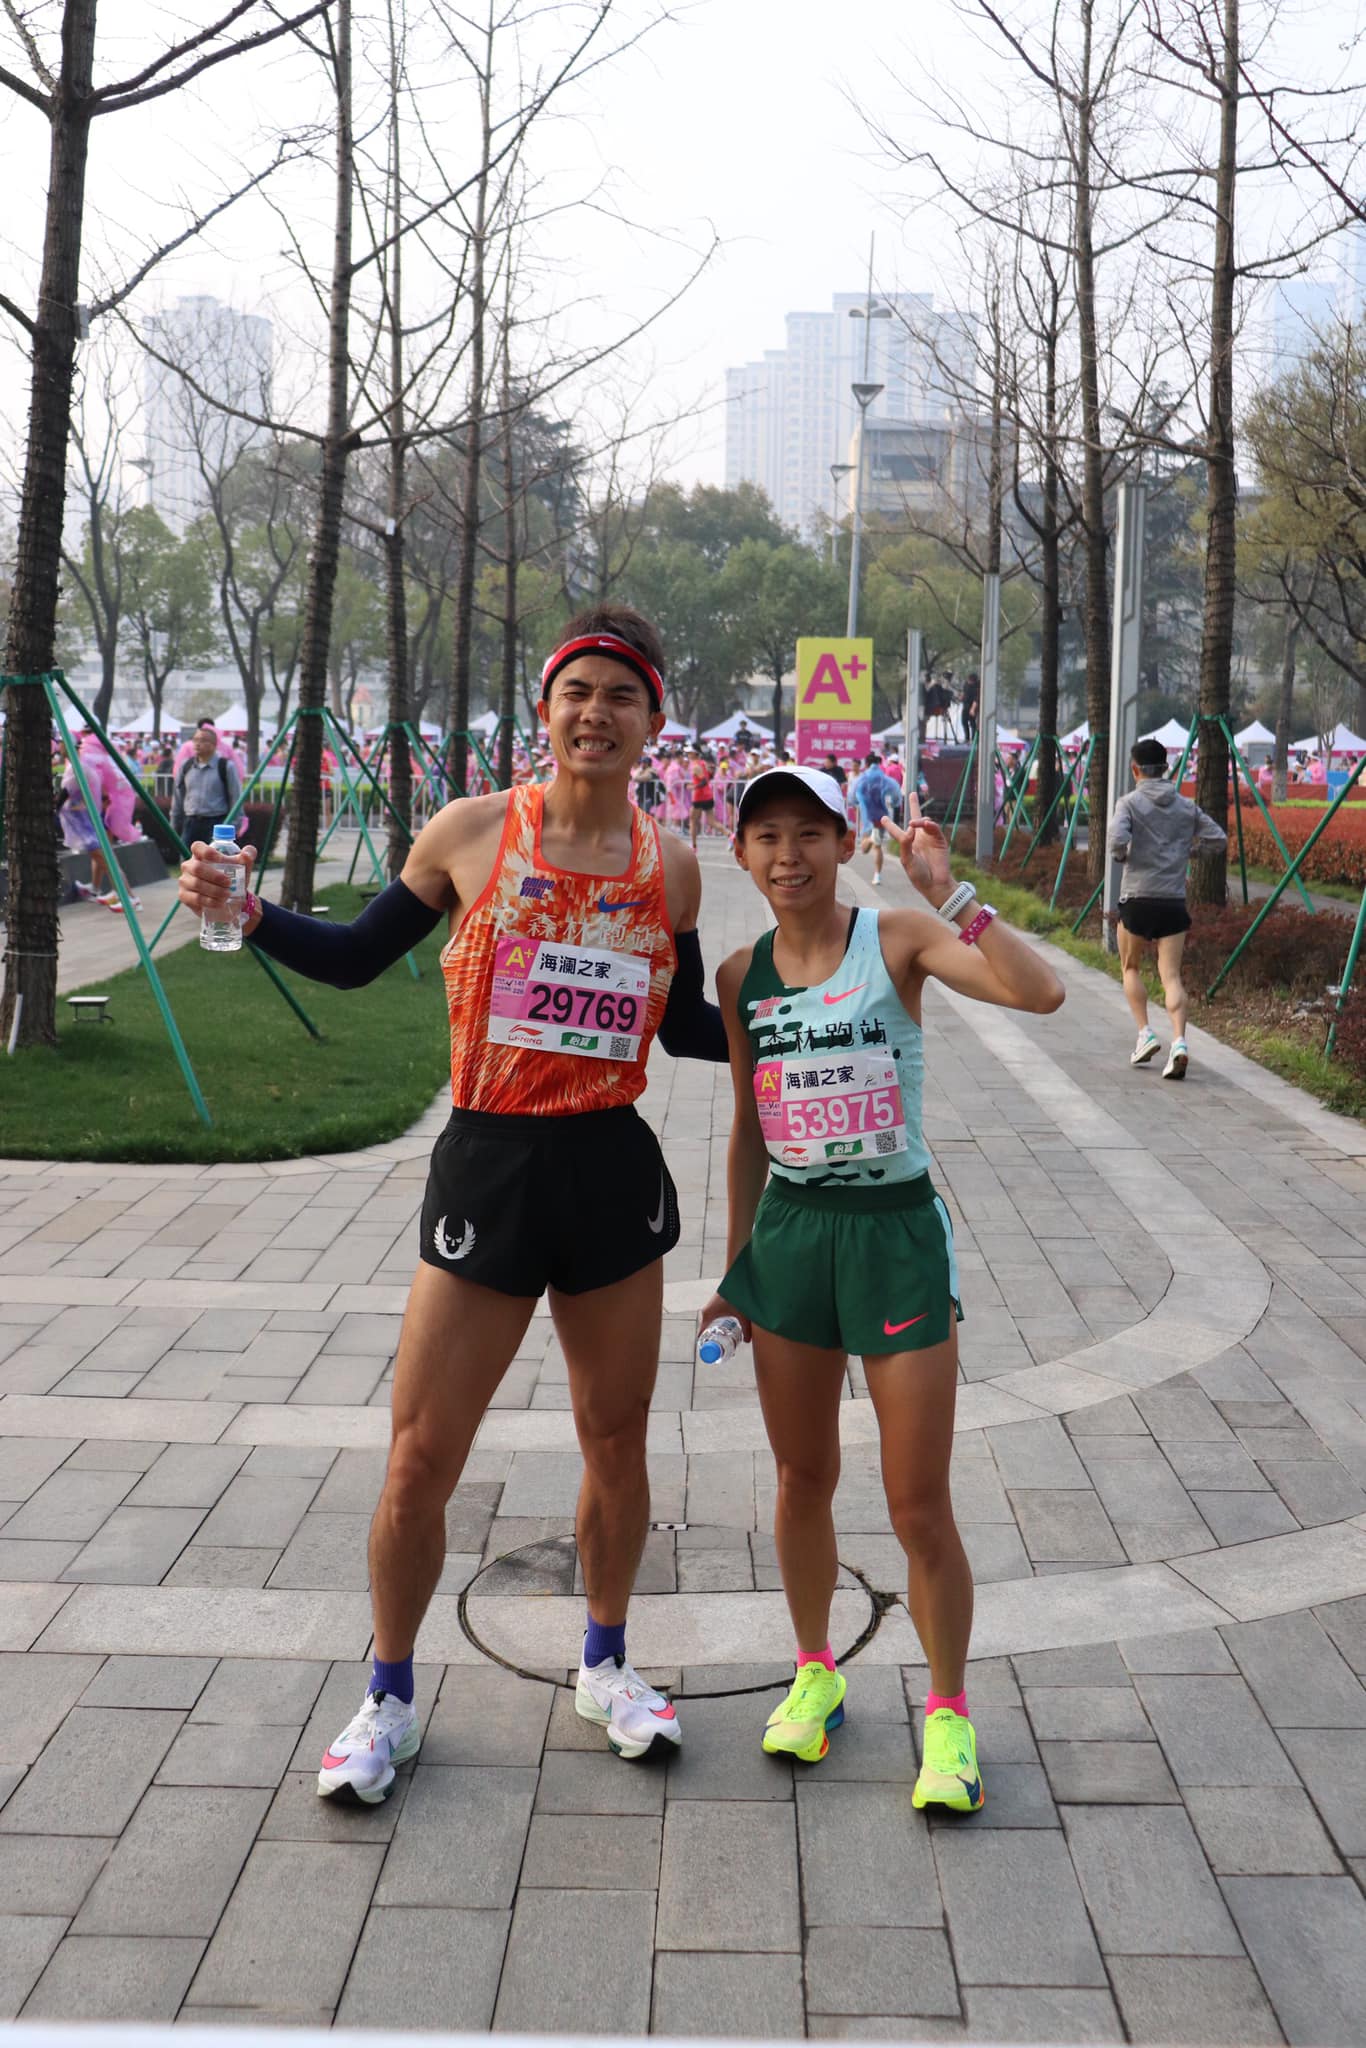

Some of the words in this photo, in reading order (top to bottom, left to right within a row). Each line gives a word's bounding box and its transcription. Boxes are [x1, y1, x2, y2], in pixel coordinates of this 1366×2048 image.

[801, 653, 867, 704] A+
[520, 887, 546, 900] VITAL
[522, 877, 555, 890] amino
[527, 912, 655, 954] 森林跑站
[505, 946, 534, 968] A+
[539, 952, 612, 979] 海澜之家
[528, 984, 638, 1033] 29769
[768, 1018, 887, 1057] 森林跑站
[761, 1071, 780, 1092] A+
[785, 1065, 855, 1090] 海澜之家
[786, 1090, 894, 1139] 53975
